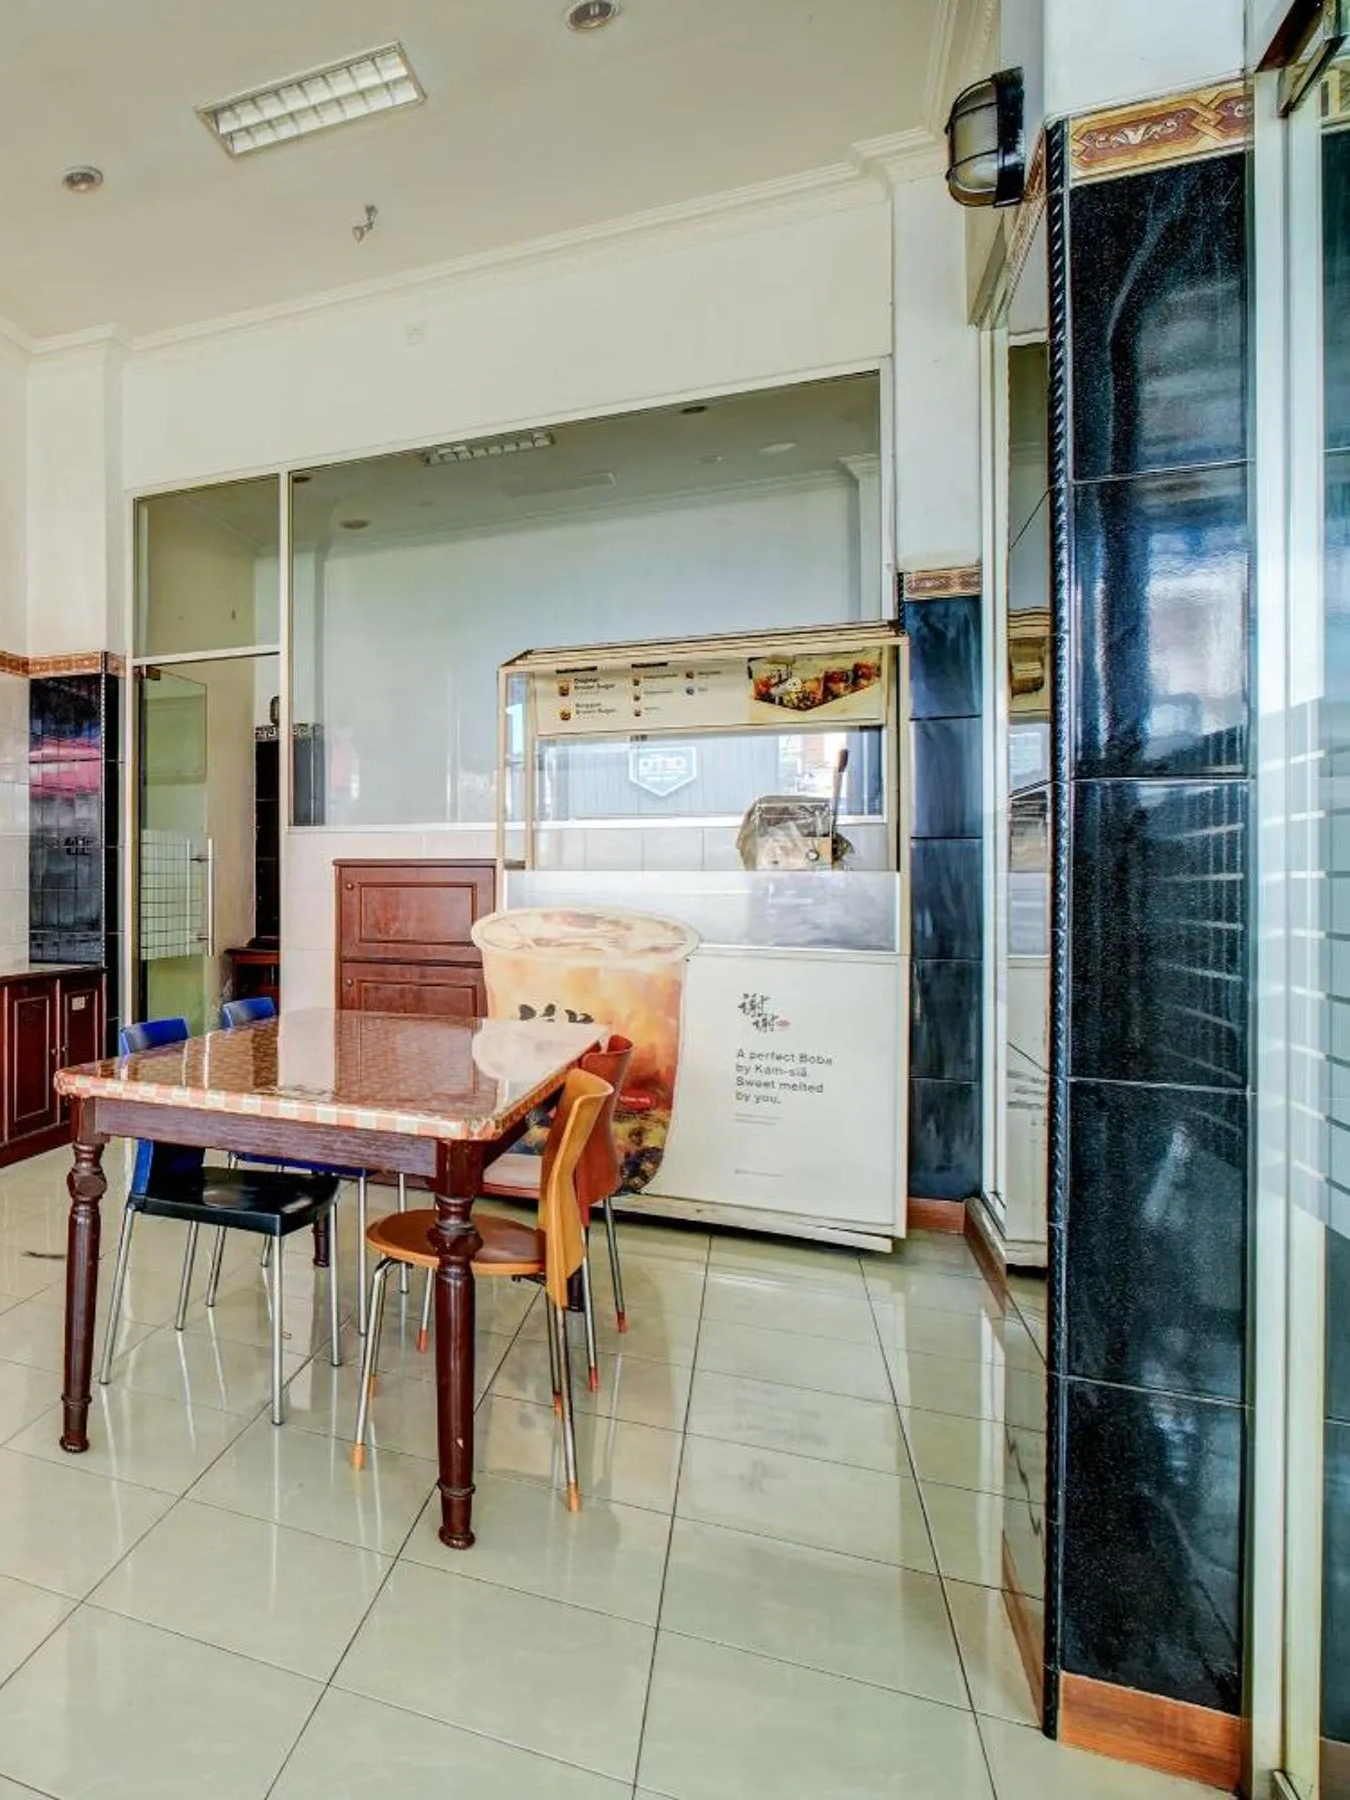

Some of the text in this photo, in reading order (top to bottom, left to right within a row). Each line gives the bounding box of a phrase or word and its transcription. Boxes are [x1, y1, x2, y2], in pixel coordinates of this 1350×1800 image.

[736, 1048, 833, 1066] A perfect Boba
[736, 1063, 751, 1075] by
[736, 1076, 824, 1094] Sweet melted
[736, 1091, 782, 1105] by you.
